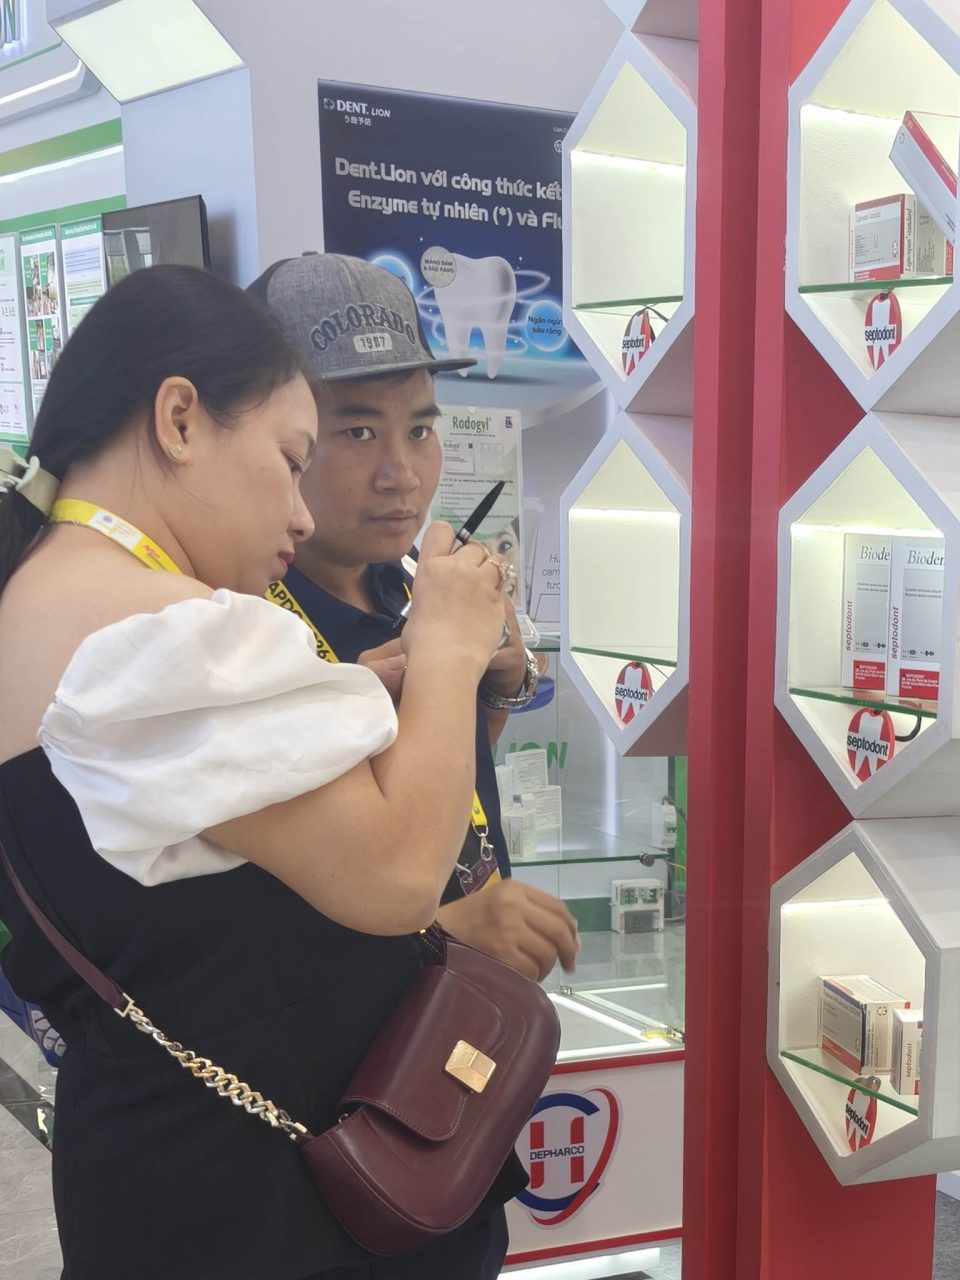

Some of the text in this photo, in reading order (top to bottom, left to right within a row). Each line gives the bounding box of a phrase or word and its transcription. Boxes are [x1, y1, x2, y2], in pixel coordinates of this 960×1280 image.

[336, 99, 391, 118] DENT. LION
[420, 169, 448, 188] với
[451, 173, 492, 196] công
[495, 176, 533, 198] thức
[536, 182, 562, 201] kết
[348, 190, 418, 215] Enzyme
[420, 198, 440, 220] tự
[444, 202, 489, 222] nhiên
[516, 210, 539, 228] và
[309, 303, 416, 351] COLORADO
[864, 326, 895, 343] septodont
[452, 416, 489, 433] Rodogyl
[860, 545, 890, 562] Biode
[891, 606, 899, 660] septodont
[615, 686, 648, 702] septodont
[847, 733, 889, 757] septodont
[846, 1103, 868, 1135] septodont
[530, 1146, 585, 1161] DEPHARCO
